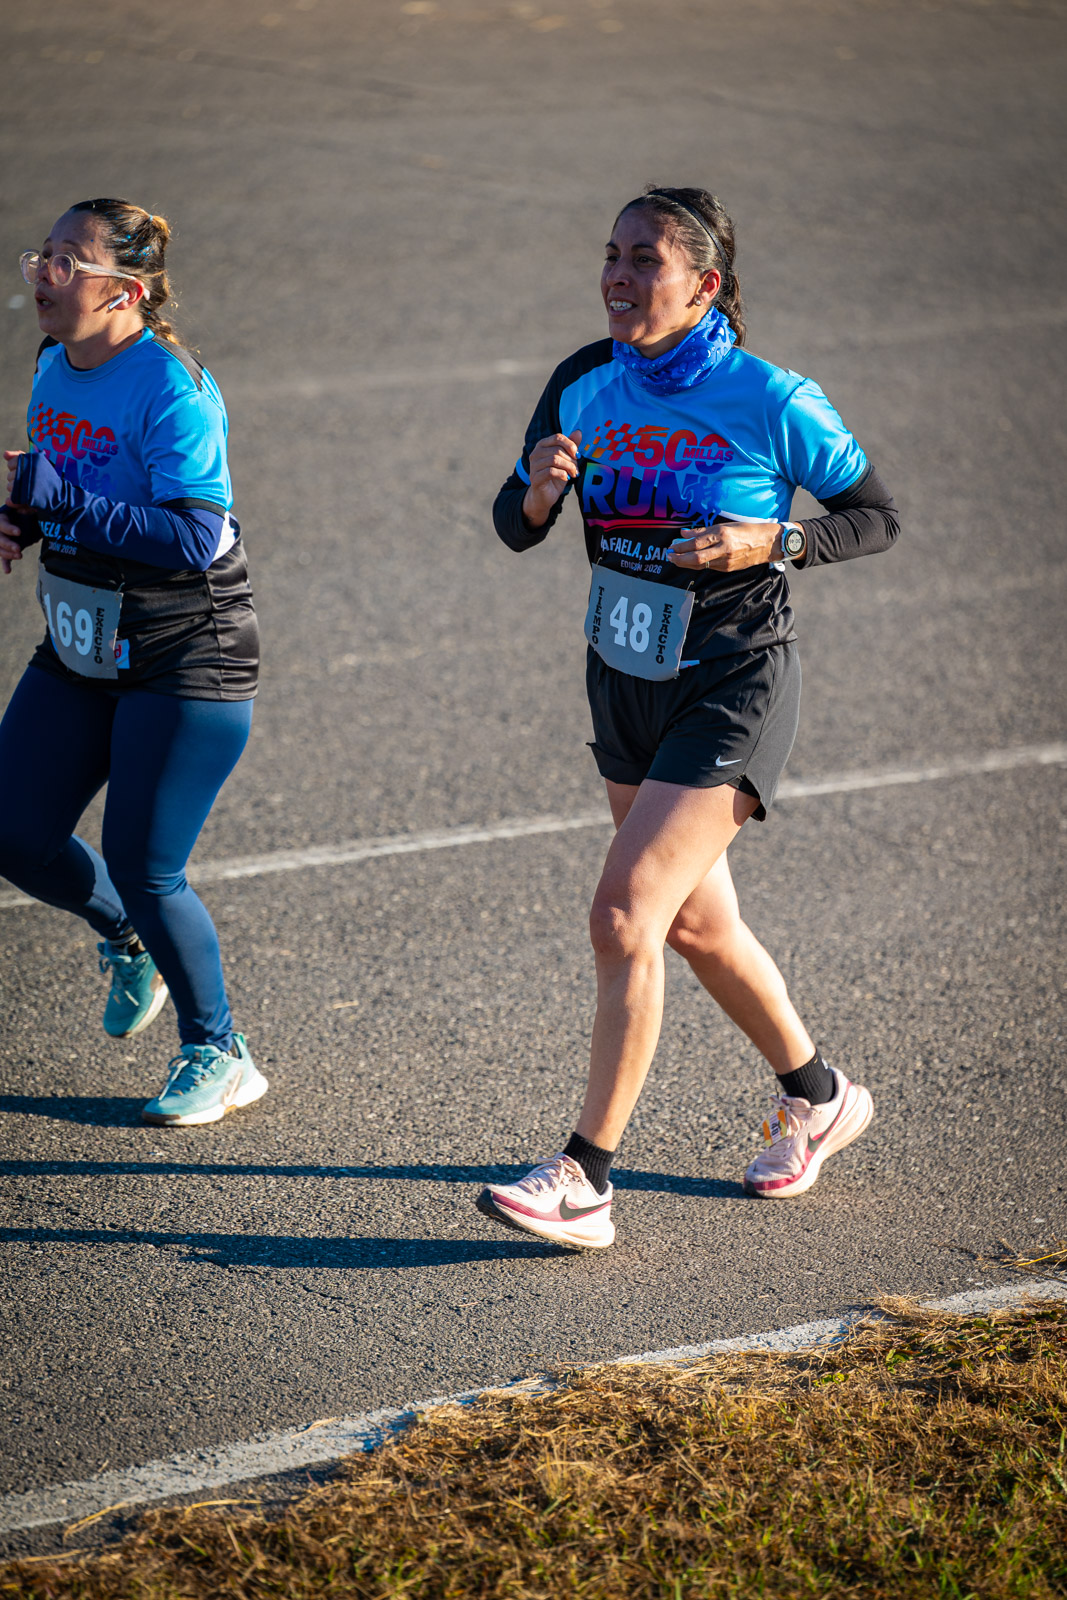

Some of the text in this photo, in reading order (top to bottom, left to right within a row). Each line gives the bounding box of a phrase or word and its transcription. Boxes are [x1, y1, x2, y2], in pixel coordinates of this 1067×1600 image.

[52, 411, 115, 467] 500
[82, 437, 119, 455] MILLAS
[634, 424, 730, 474] 500
[682, 446, 734, 462] MILLAS
[582, 462, 700, 518] RUN
[644, 564, 662, 575] 2026
[43, 592, 94, 656] 169
[94, 607, 105, 665] EXACTO
[591, 586, 605, 645] TIEMPO
[609, 596, 653, 653] 48
[655, 603, 673, 665] EXACTO
